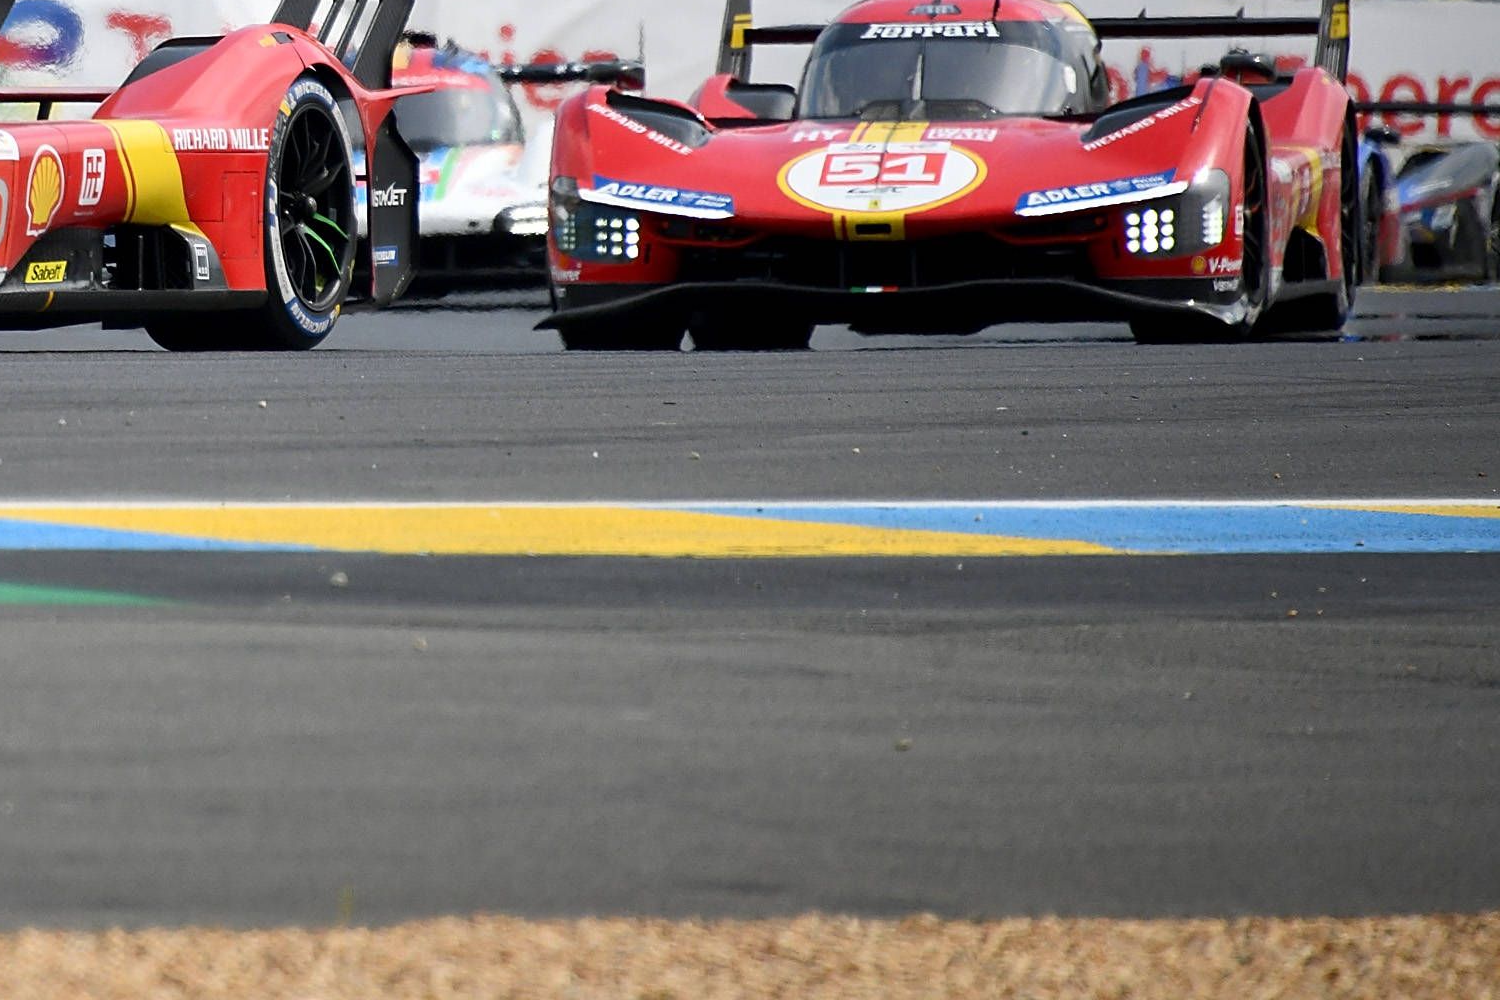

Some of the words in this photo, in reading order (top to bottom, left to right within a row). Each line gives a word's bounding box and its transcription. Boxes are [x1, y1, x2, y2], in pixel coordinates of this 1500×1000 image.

[860, 21, 1000, 39] Ferrari
[173, 128, 228, 150] RICHARD
[229, 128, 269, 150] MILLE
[826, 154, 935, 182] 51
[599, 182, 679, 202] ADLER
[1027, 183, 1110, 206] ADLER
[31, 264, 63, 281] Sabelt
